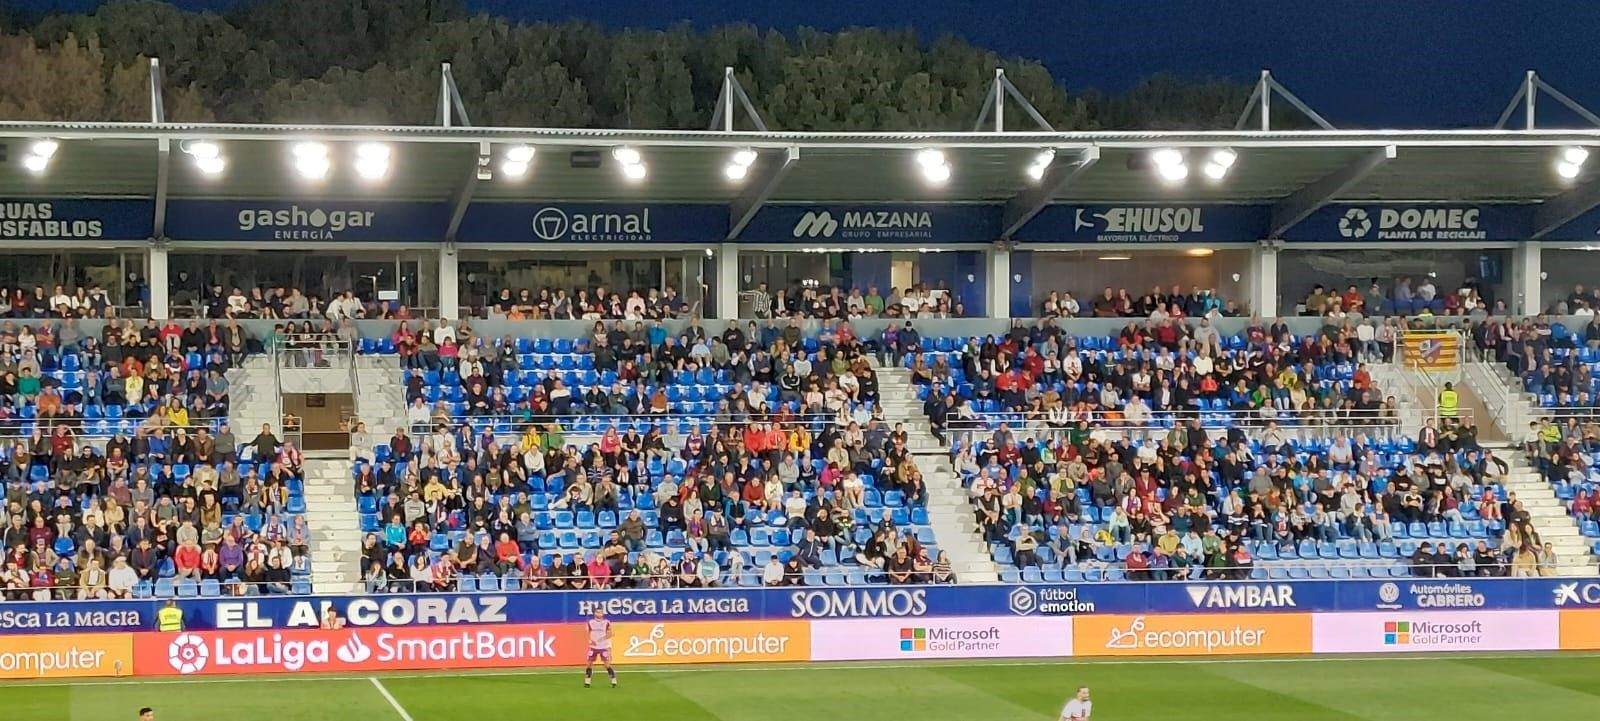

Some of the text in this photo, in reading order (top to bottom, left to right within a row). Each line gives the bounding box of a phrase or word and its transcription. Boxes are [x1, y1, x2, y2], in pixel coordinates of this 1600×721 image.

[572, 208, 651, 233] arnal
[843, 212, 932, 228] MAZANA
[1379, 209, 1480, 229] DOMEC
[0, 220, 102, 237] SFABLOS
[877, 231, 932, 239] EMPRESARIAL
[1378, 231, 1486, 239] PLANTA DE RECICLAJE
[1040, 587, 1077, 600] fútbol
[1417, 594, 1485, 607] CABRERO
[791, 589, 927, 618] SOMMOS
[1040, 600, 1094, 613] emotion
[216, 597, 507, 628] EL ALCORAZ
[929, 628, 1000, 640] Microsoft
[1412, 621, 1482, 633] Microsoft
[664, 632, 789, 660] ecomputer
[929, 640, 1000, 651] Gold Partner
[1144, 626, 1266, 652] ecomputer
[1412, 634, 1481, 645] Gold Partner
[215, 630, 555, 670] LaLiga SmartBank
